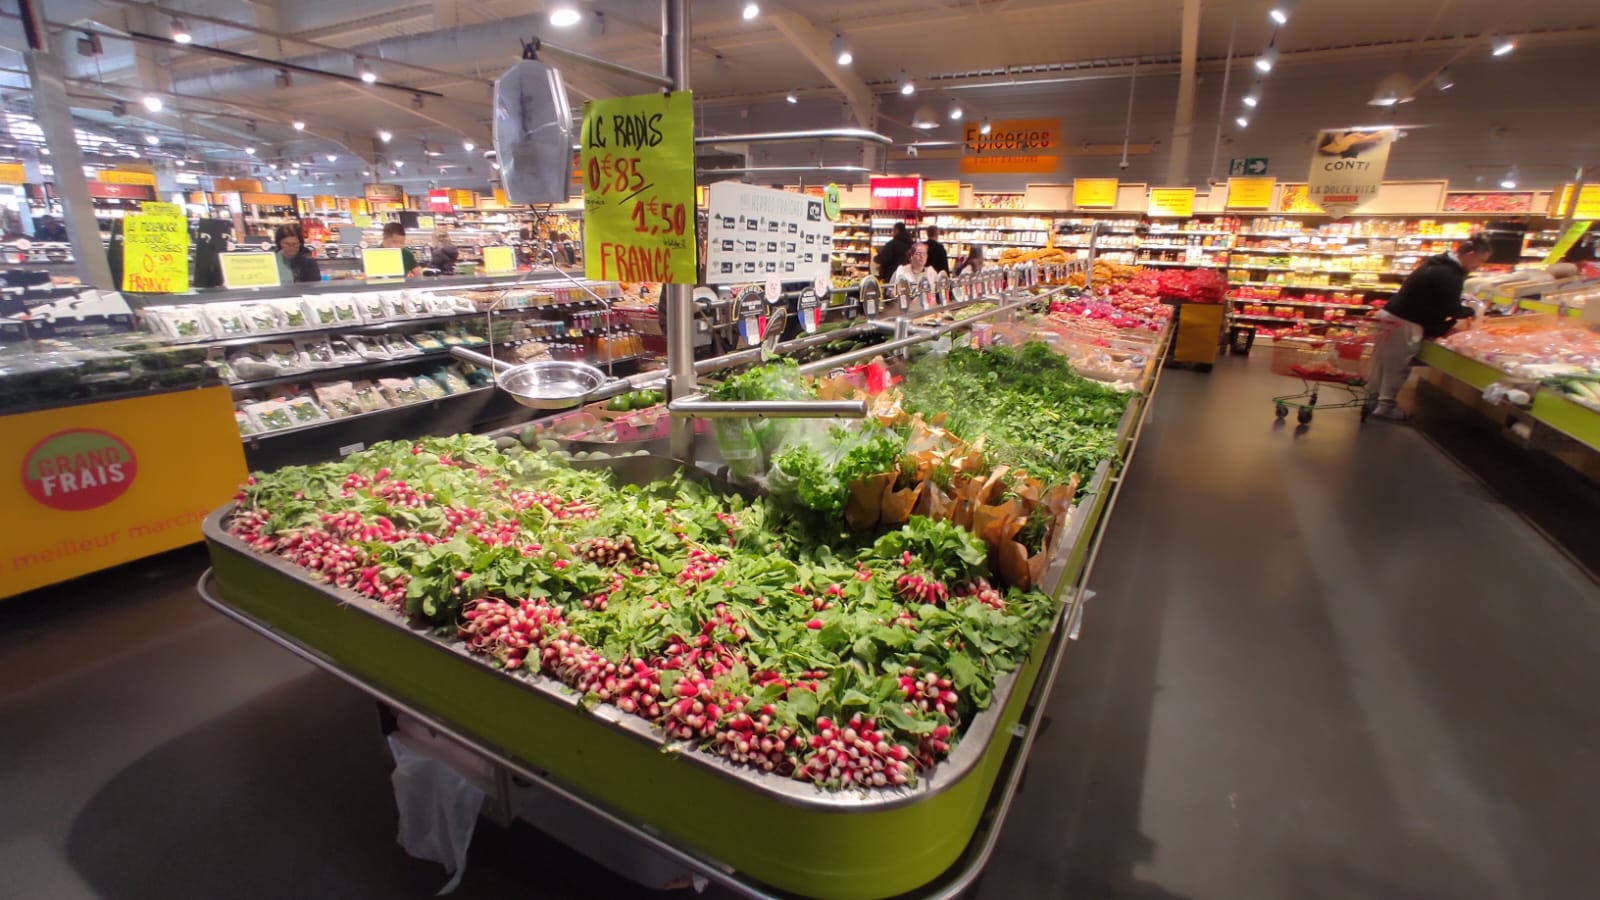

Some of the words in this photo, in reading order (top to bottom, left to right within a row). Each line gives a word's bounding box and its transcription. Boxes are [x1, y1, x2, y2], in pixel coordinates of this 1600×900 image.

[613, 112, 663, 151] RADIS
[1324, 160, 1370, 172] CONTI
[600, 241, 673, 284] FRANCE
[37, 446, 121, 476] GRAND
[41, 463, 125, 497] FRAIS
[13, 531, 120, 571] meilleur
